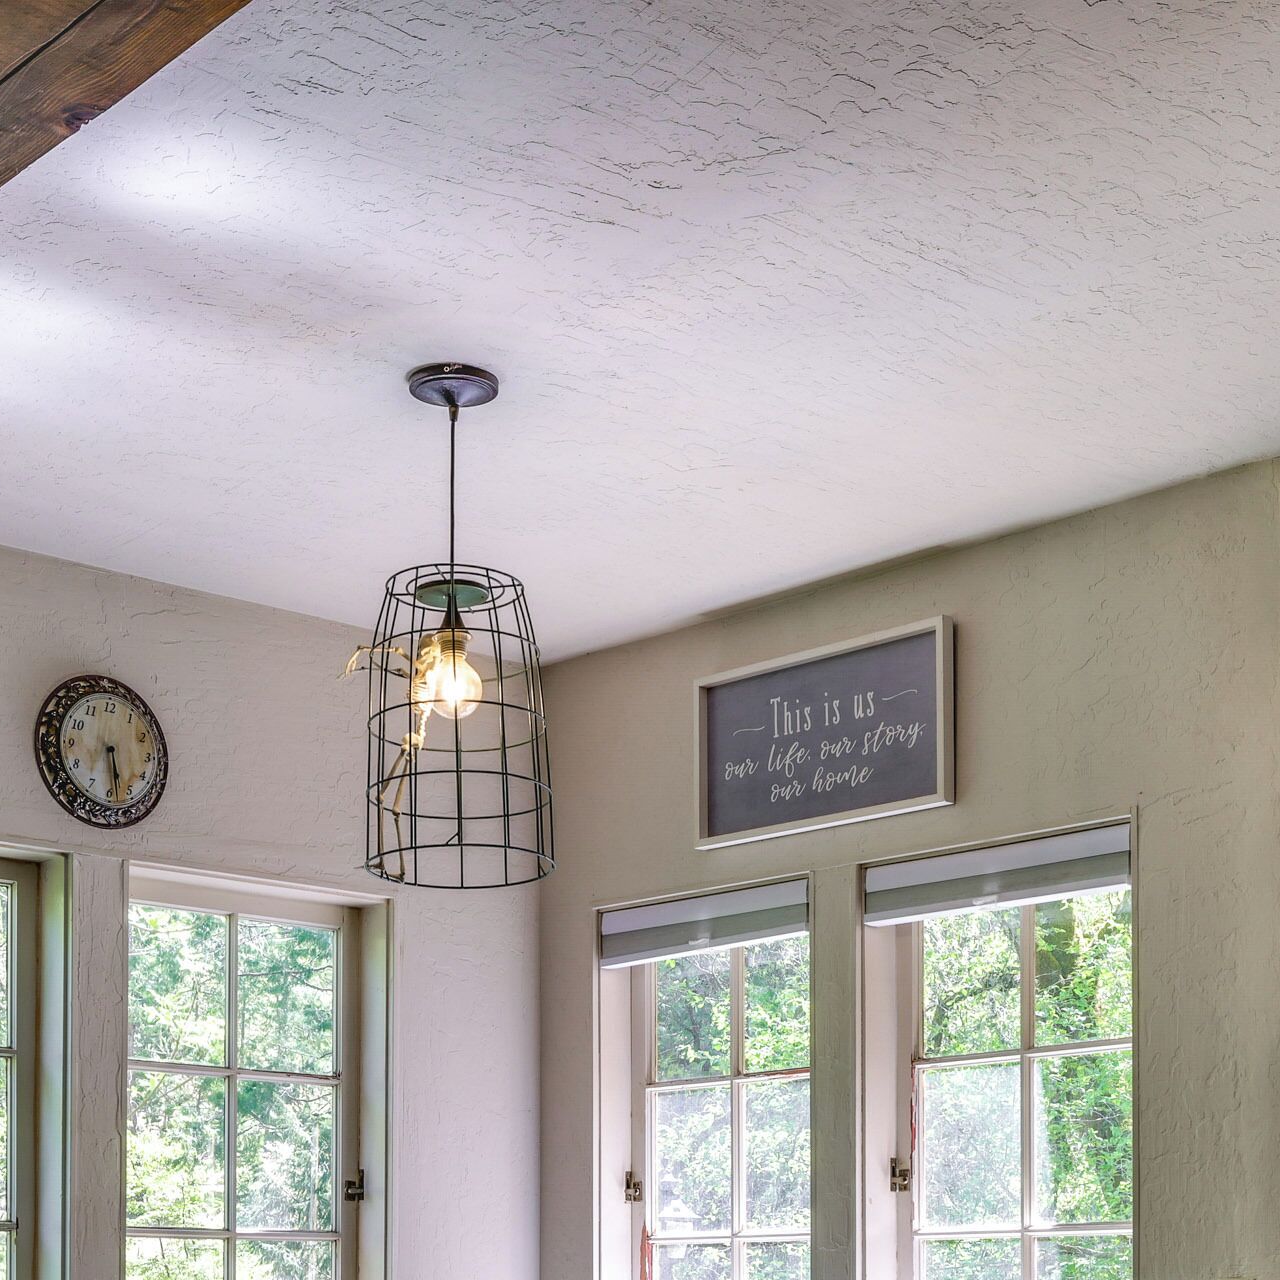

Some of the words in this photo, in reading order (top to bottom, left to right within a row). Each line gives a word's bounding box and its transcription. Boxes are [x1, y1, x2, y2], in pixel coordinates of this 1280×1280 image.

[85, 705, 96, 716] 11
[104, 702, 116, 714] 12
[128, 713, 132, 723] 1
[769, 696, 812, 738] This
[824, 691, 840, 727] is
[853, 690, 875, 720] us
[71, 719, 84, 731] 10
[68, 737, 75, 748] 9
[139, 732, 146, 743] 2
[144, 752, 151, 763] 3
[725, 758, 759, 781] our
[820, 736, 857, 760] our
[72, 758, 80, 769] 8
[139, 771, 146, 781] 4
[89, 778, 96, 789] 7
[770, 781, 806, 803] our
[812, 764, 874, 793] home
[106, 787, 113, 798] 6
[126, 784, 133, 795] 5
